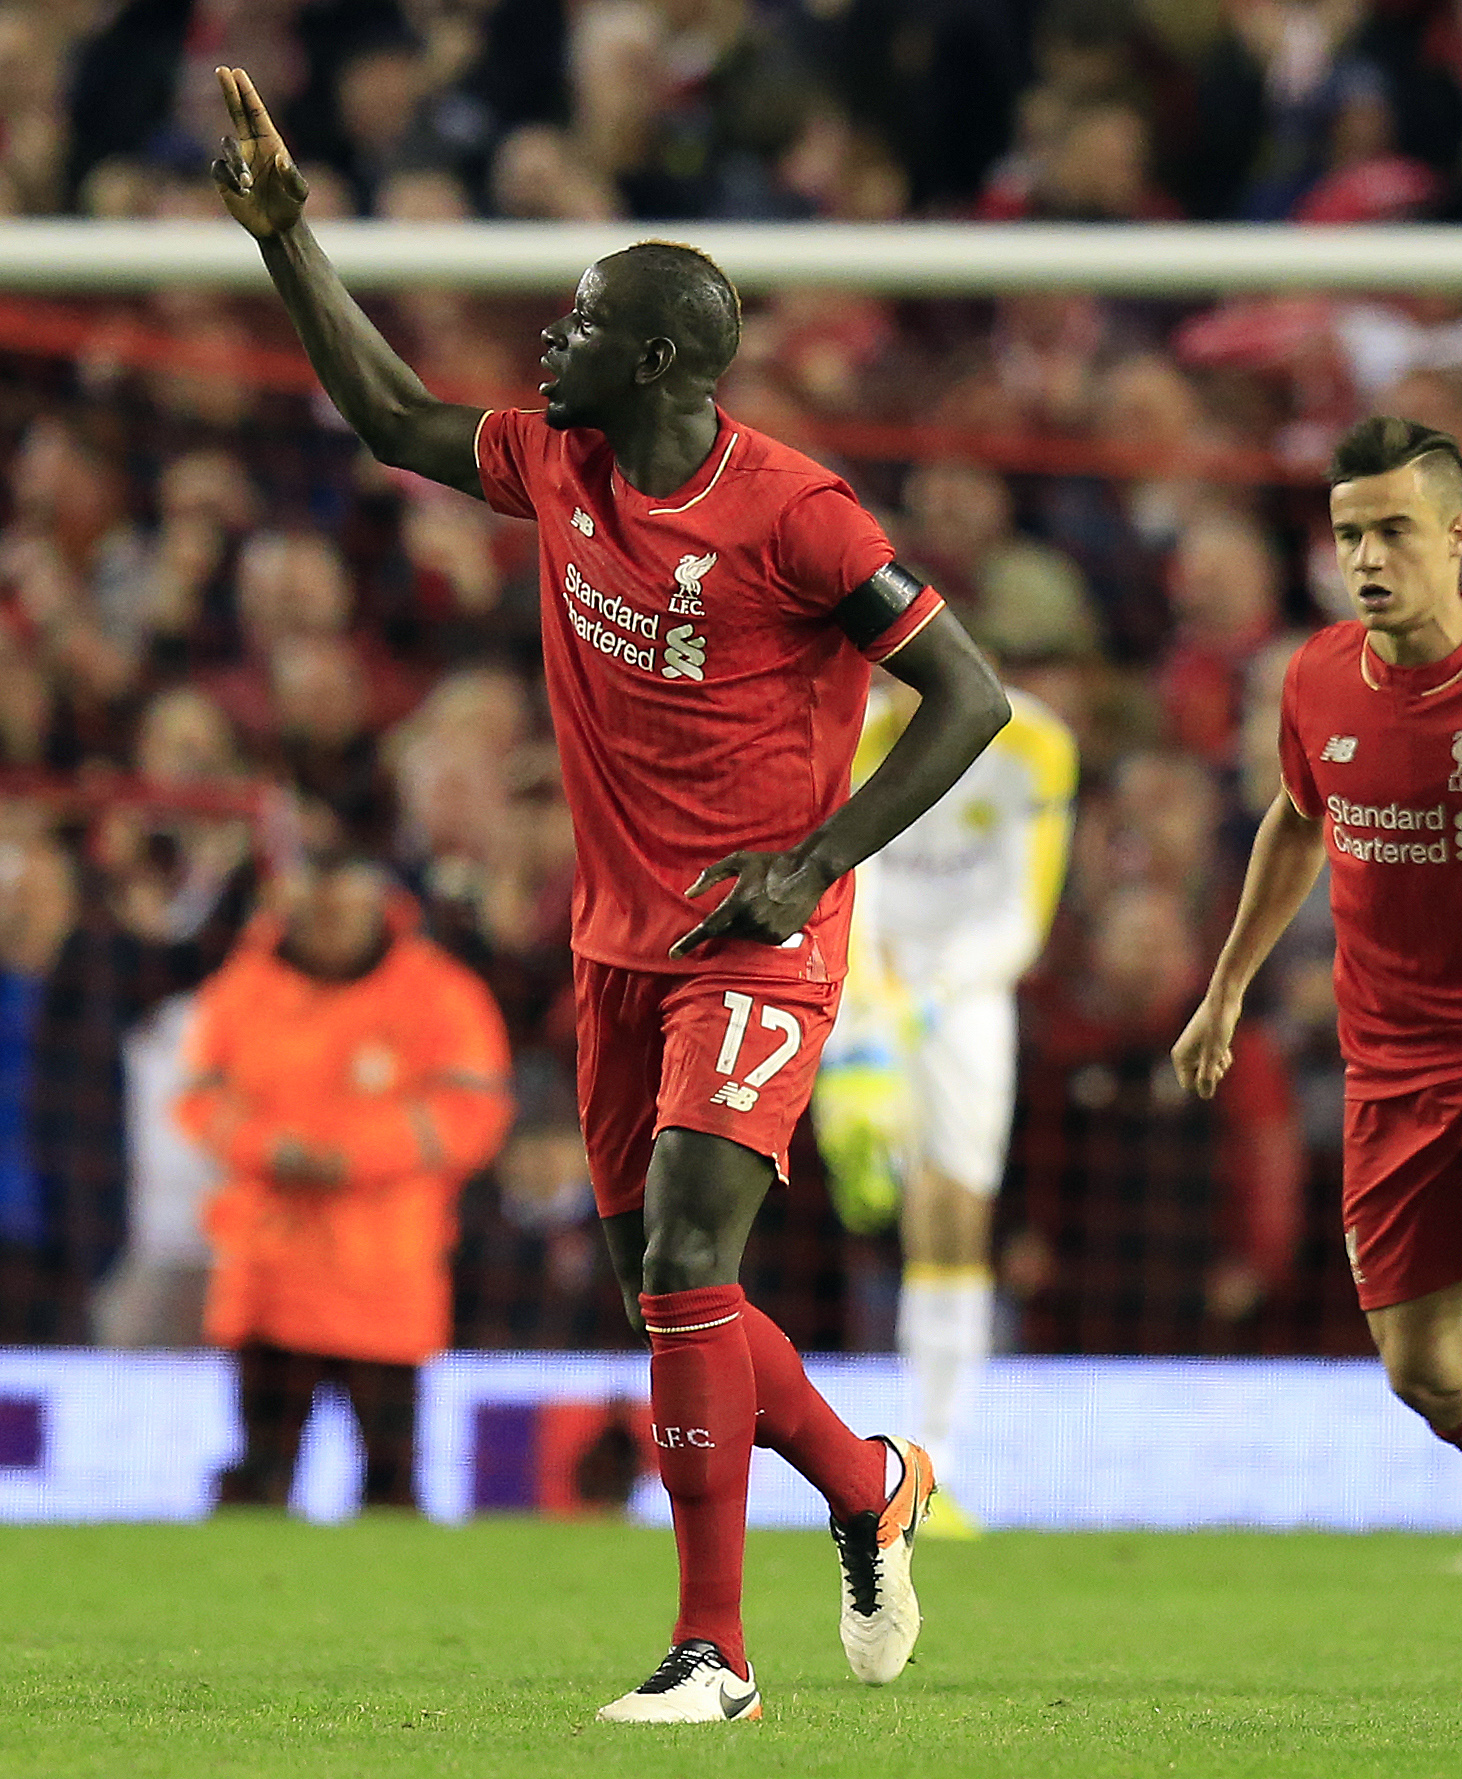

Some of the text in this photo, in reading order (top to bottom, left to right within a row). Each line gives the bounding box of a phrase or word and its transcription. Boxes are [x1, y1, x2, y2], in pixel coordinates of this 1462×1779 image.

[564, 562, 659, 641] Standard
[1327, 793, 1444, 831] Standard
[1333, 825, 1447, 864] Chartered
[715, 990, 802, 1088] 17
